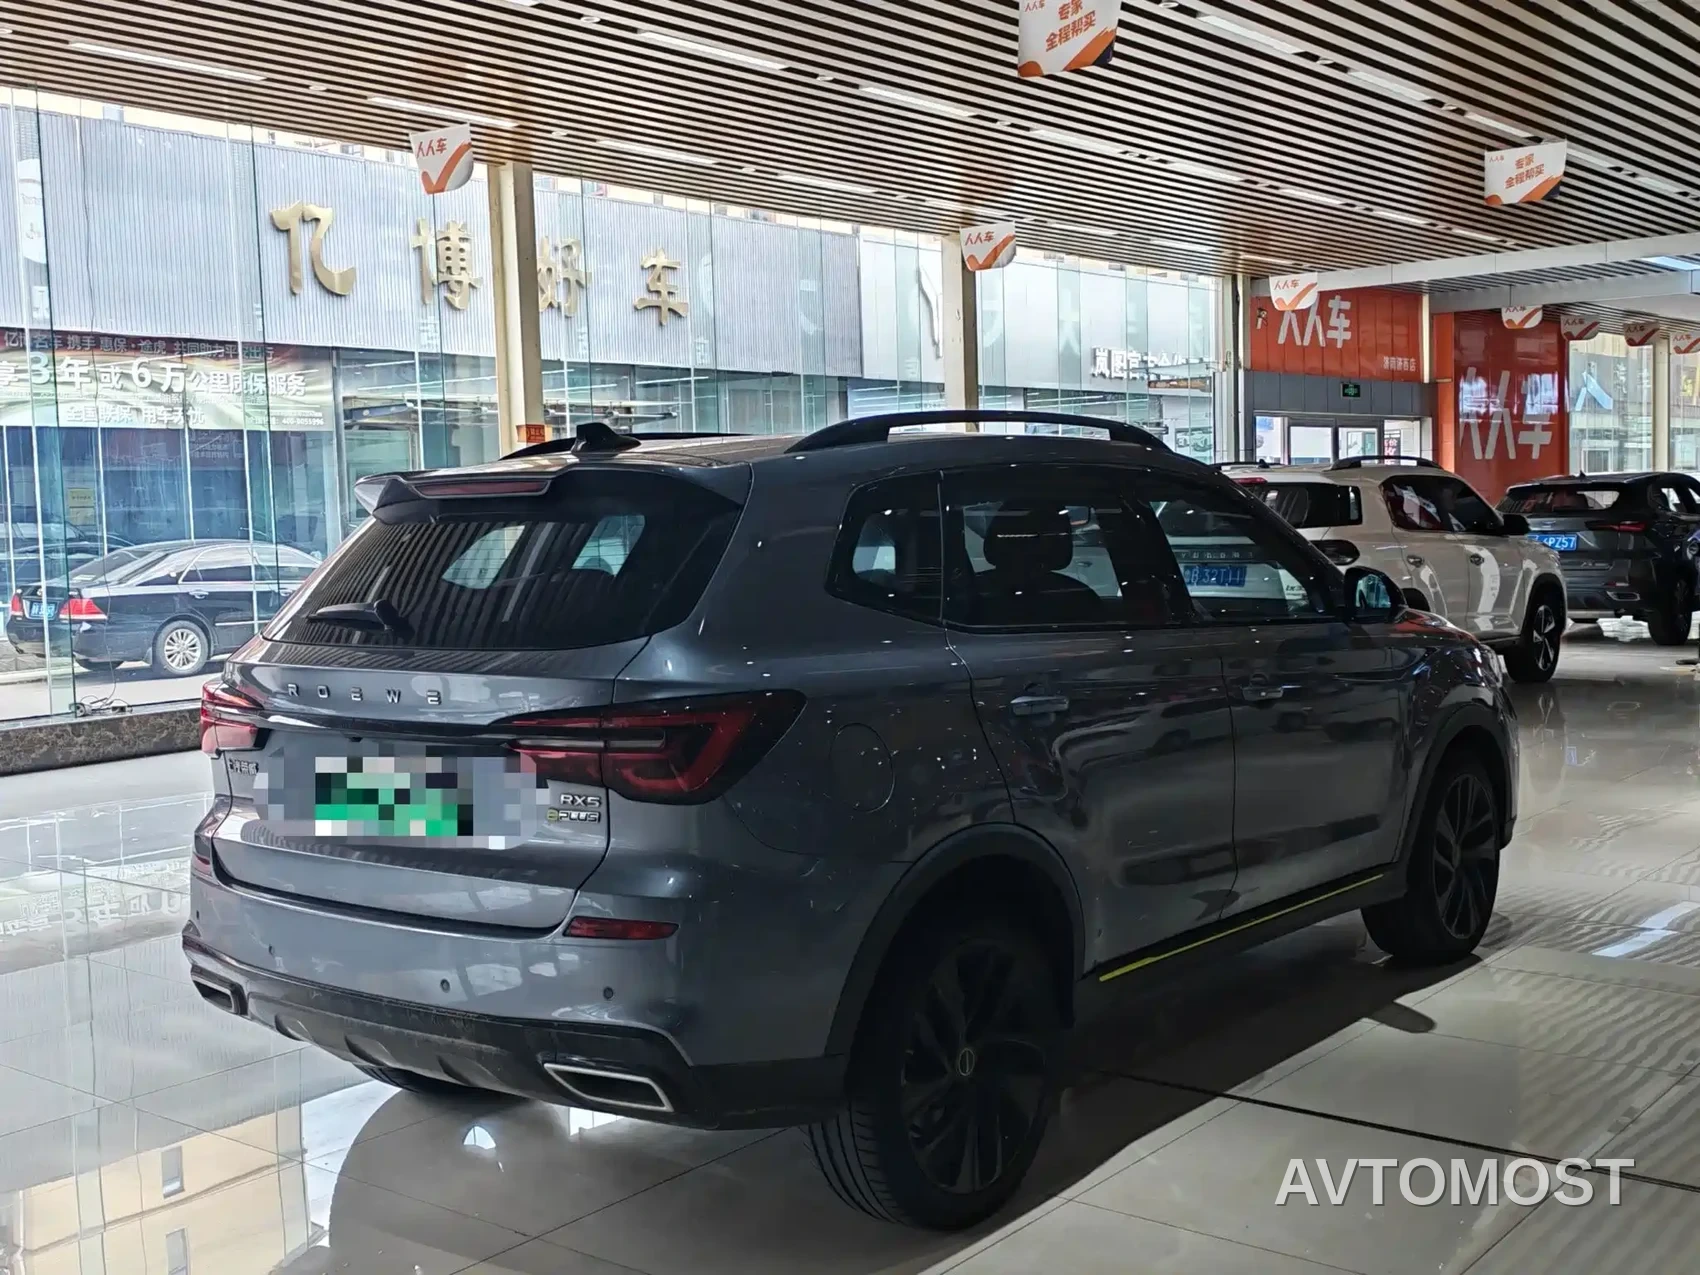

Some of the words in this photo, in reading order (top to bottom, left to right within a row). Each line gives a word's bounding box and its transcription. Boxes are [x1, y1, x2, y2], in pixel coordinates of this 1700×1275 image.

[1059, 0, 1084, 20] 专家
[1046, 10, 1096, 52] 全程帮买
[416, 137, 448, 159] 人人车
[965, 230, 995, 246] 人人车
[1274, 279, 1300, 291] 人人车
[1278, 295, 1352, 349] 人人车
[287, 683, 442, 705] ROEWE
[560, 793, 600, 807] RX5
